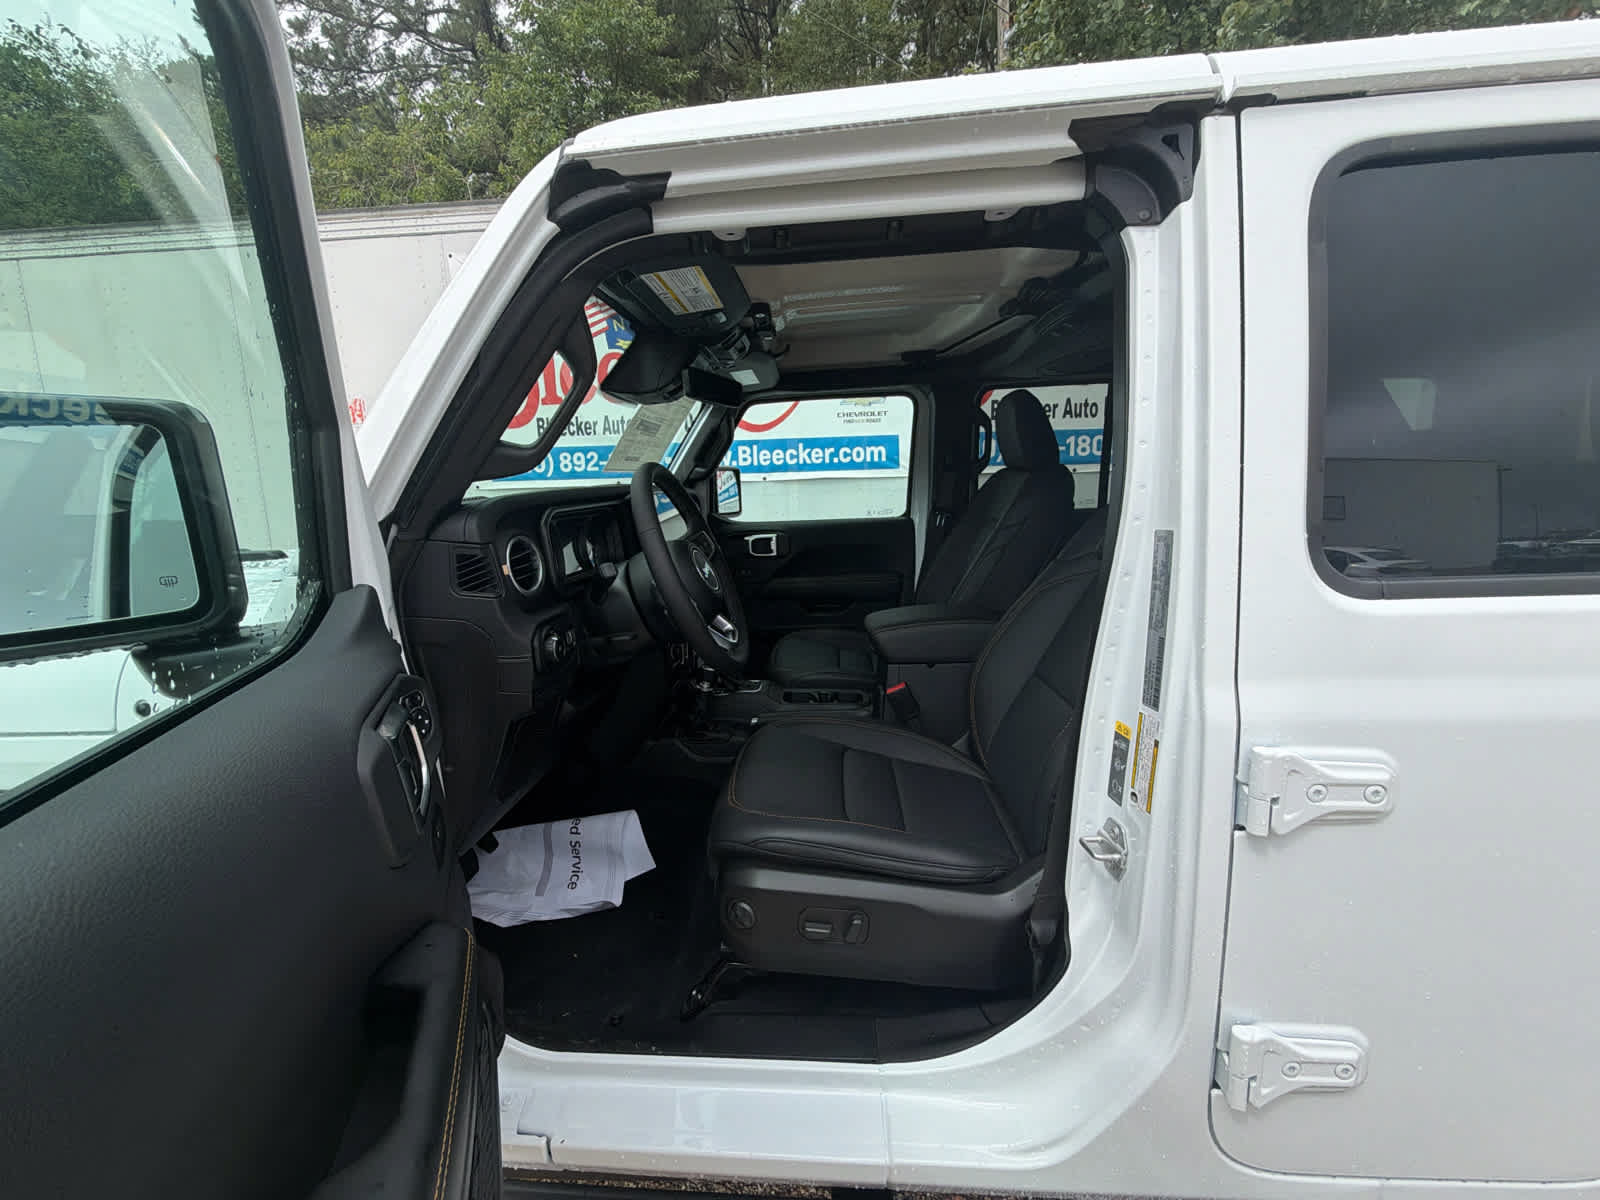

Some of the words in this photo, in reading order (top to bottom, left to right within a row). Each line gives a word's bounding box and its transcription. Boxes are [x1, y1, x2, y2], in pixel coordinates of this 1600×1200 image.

[837, 410, 888, 418] CHEVROLET
[1062, 397, 1098, 419] Auto
[567, 840, 584, 890] Service
